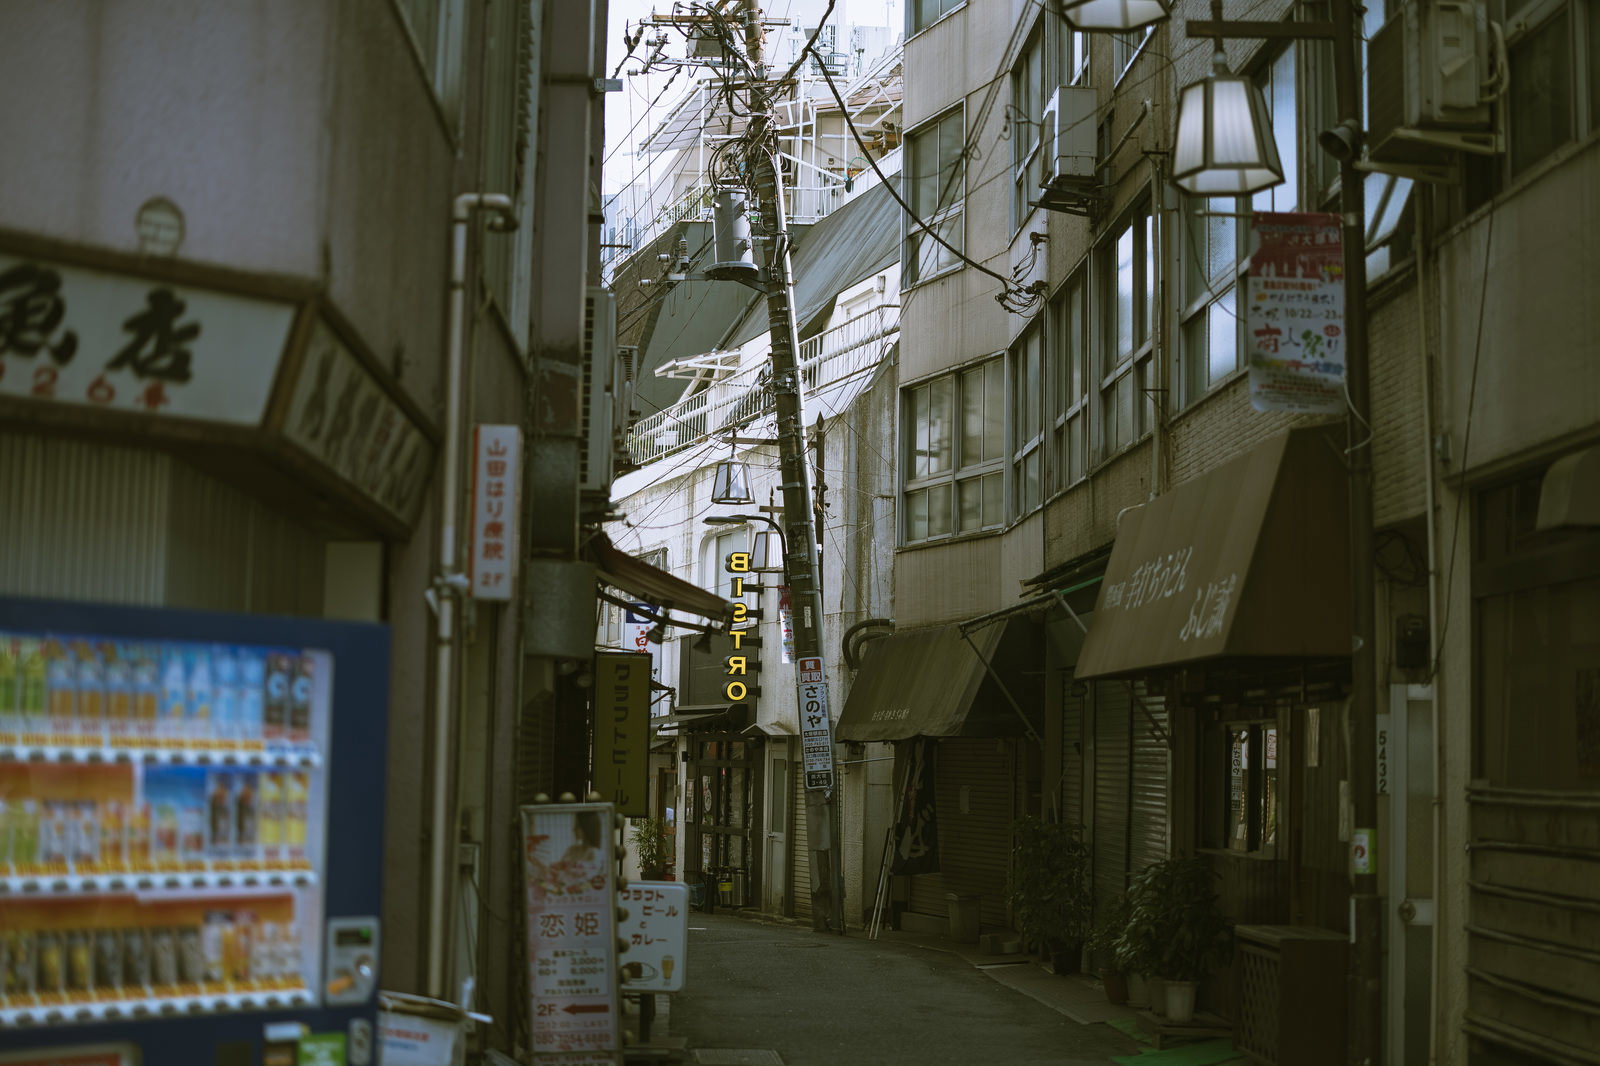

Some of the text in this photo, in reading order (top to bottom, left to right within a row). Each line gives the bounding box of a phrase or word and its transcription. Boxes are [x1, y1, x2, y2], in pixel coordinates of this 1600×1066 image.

[805, 686, 822, 728] さのや
[643, 905, 678, 917] ビール
[631, 934, 667, 945] カレー
